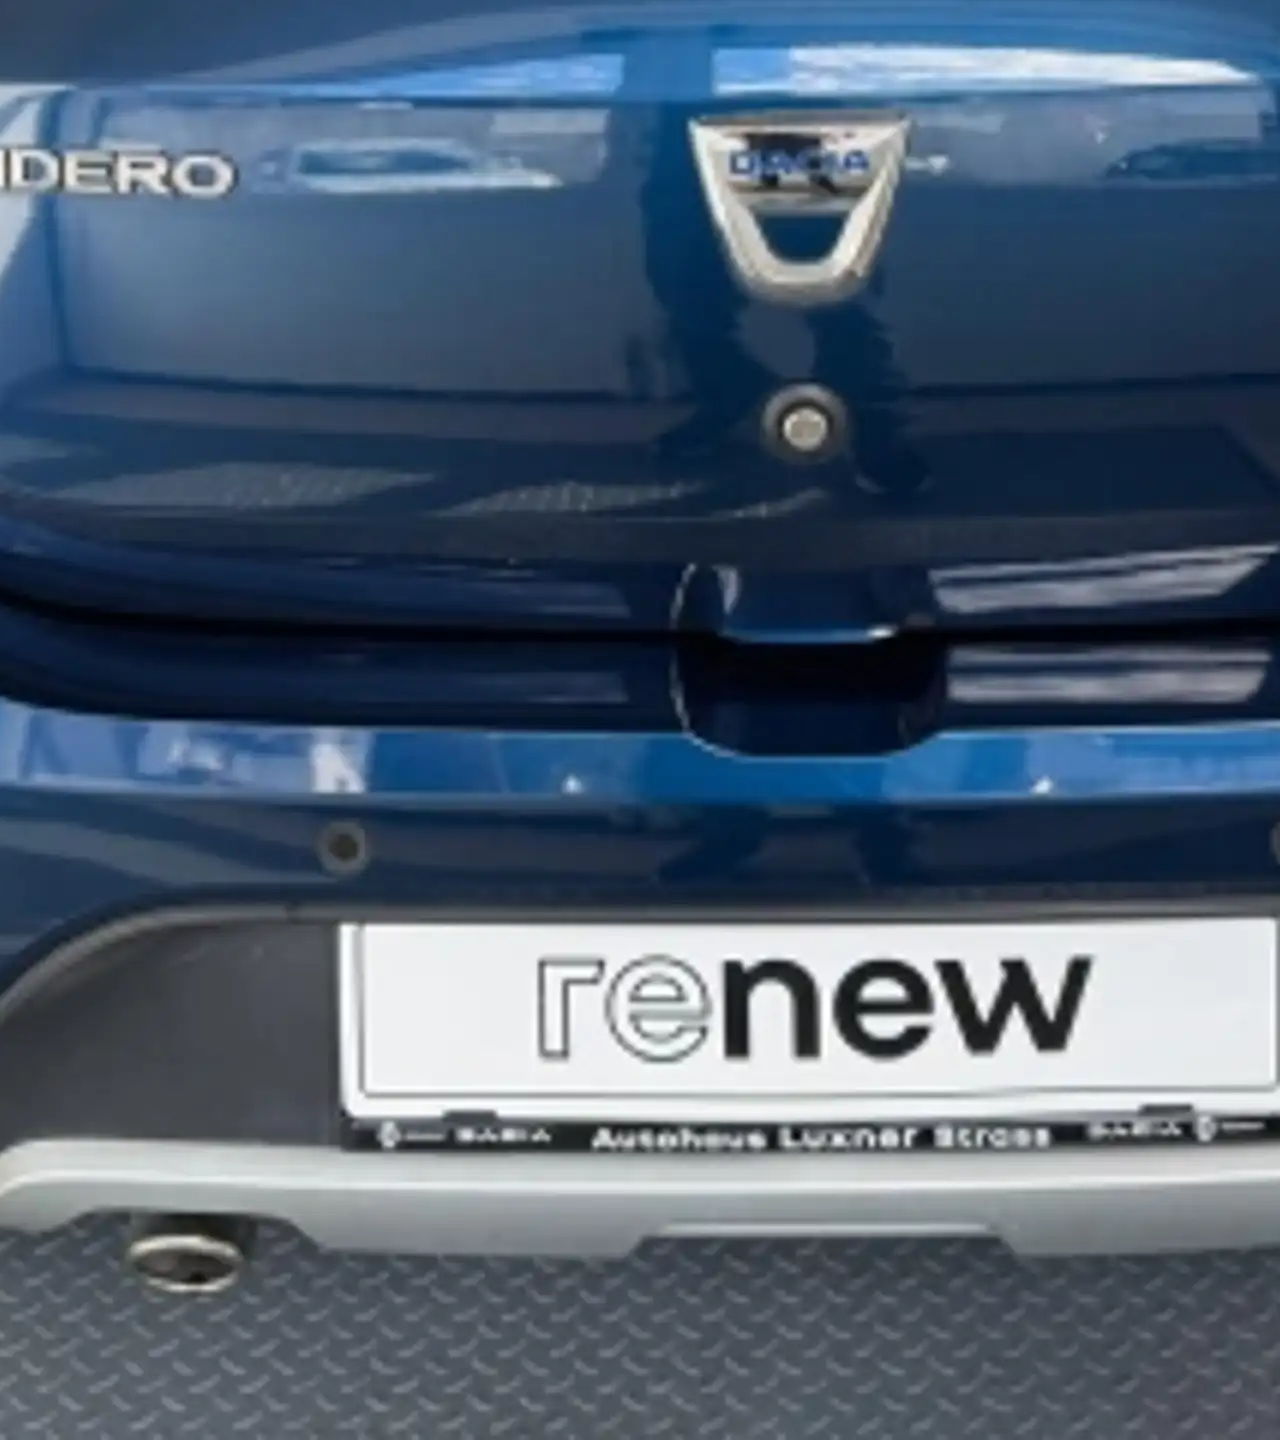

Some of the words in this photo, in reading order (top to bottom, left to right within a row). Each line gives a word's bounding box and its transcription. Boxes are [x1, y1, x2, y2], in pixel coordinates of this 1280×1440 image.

[537, 953, 1096, 1062] renew
[591, 1126, 768, 1150] Autohaus
[779, 1126, 918, 1149] Luxner
